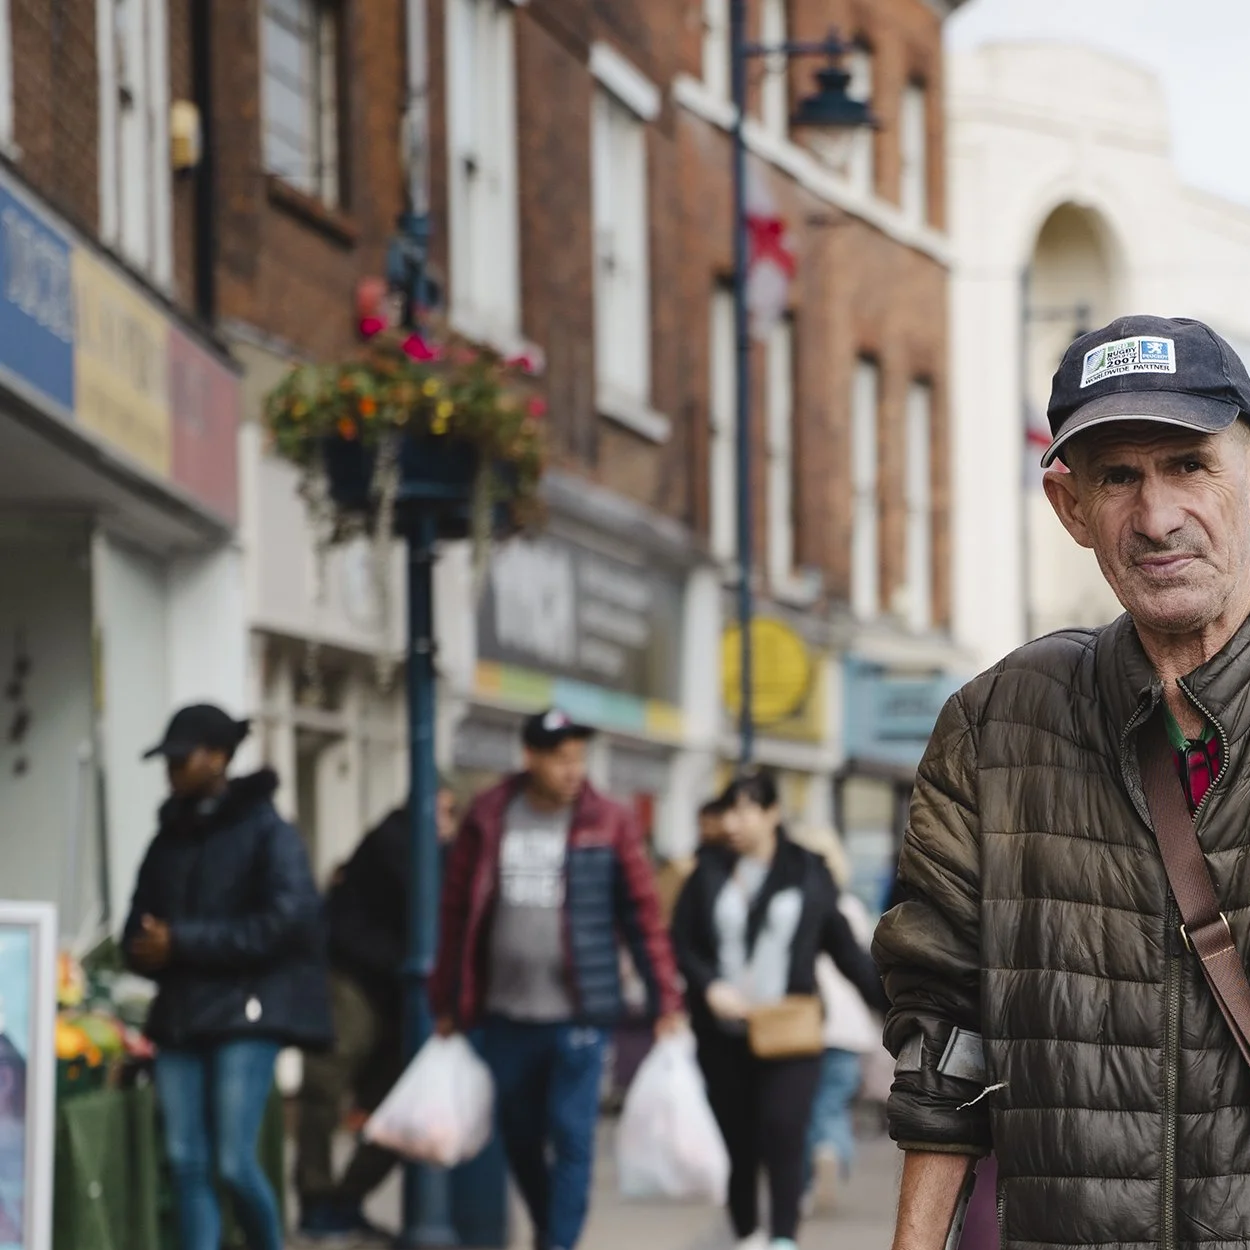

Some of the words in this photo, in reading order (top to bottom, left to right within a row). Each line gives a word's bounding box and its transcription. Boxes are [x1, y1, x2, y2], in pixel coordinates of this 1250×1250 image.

[1107, 346, 1137, 358] RUGBY
[1106, 356, 1137, 368] 2007
[1085, 366, 1130, 385] WORLDWIDE
[1133, 364, 1170, 372] PARTNER
